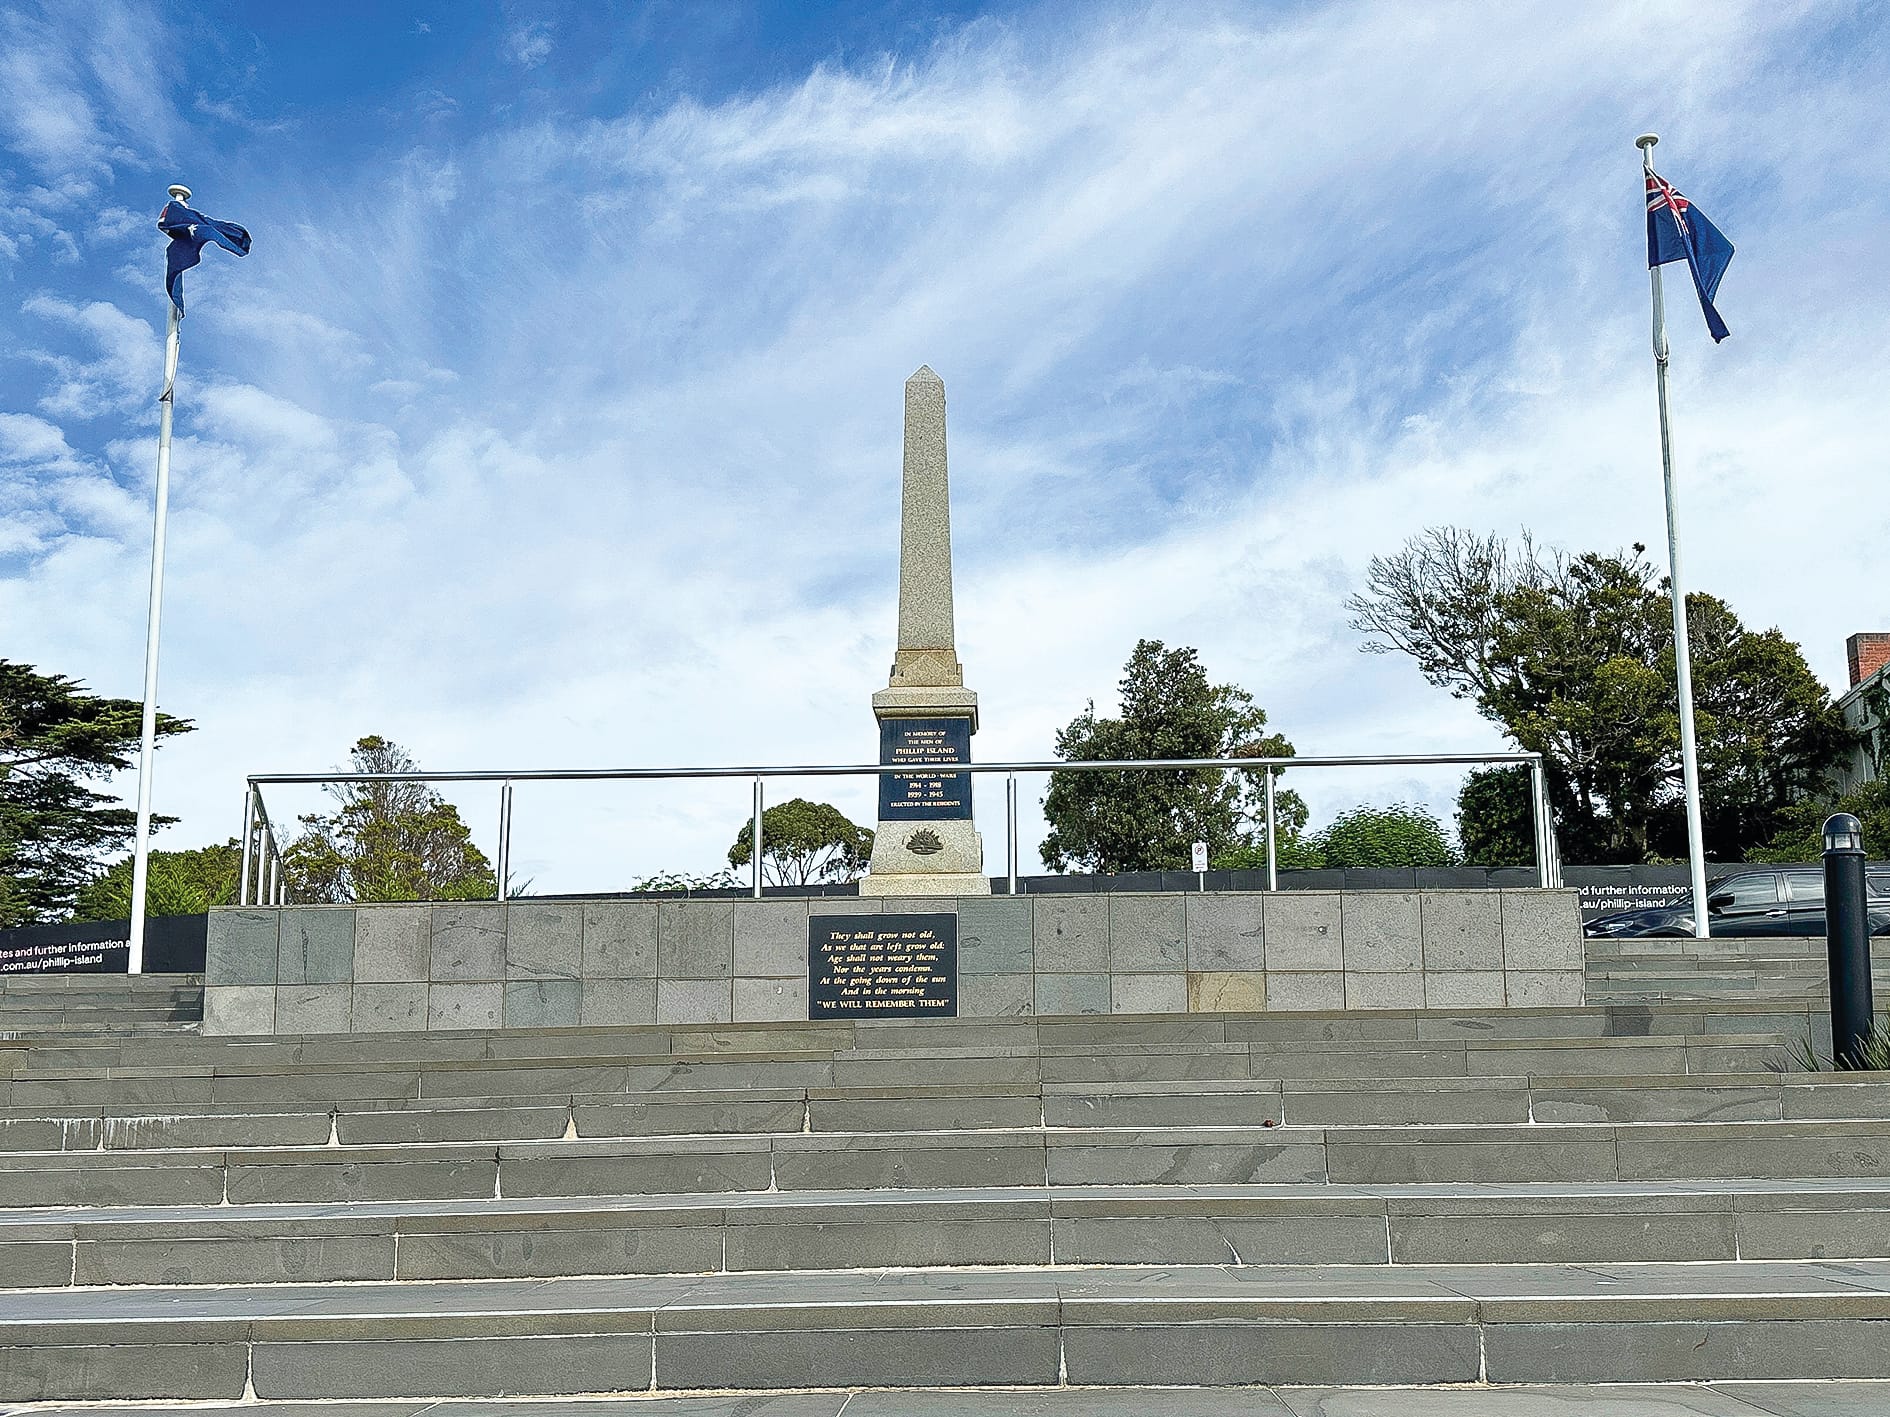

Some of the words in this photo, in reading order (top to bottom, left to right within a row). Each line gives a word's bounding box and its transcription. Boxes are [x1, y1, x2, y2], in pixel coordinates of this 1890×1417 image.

[1578, 886, 1588, 895] nd
[1591, 886, 1627, 895] further
[1629, 885, 1687, 894] information
[830, 932, 851, 941] They
[15, 947, 32, 956] and
[35, 945, 67, 955] further
[69, 940, 123, 952] information
[887, 943, 902, 952] left
[828, 955, 843, 964] Age
[888, 955, 912, 963] weary
[916, 953, 938, 961] them,
[869, 967, 891, 975] years
[850, 977, 872, 986] going
[902, 976, 912, 984] of
[891, 987, 925, 996] morning
[817, 1001, 836, 1009] "WE
[866, 1000, 915, 1008] REMEMBER
